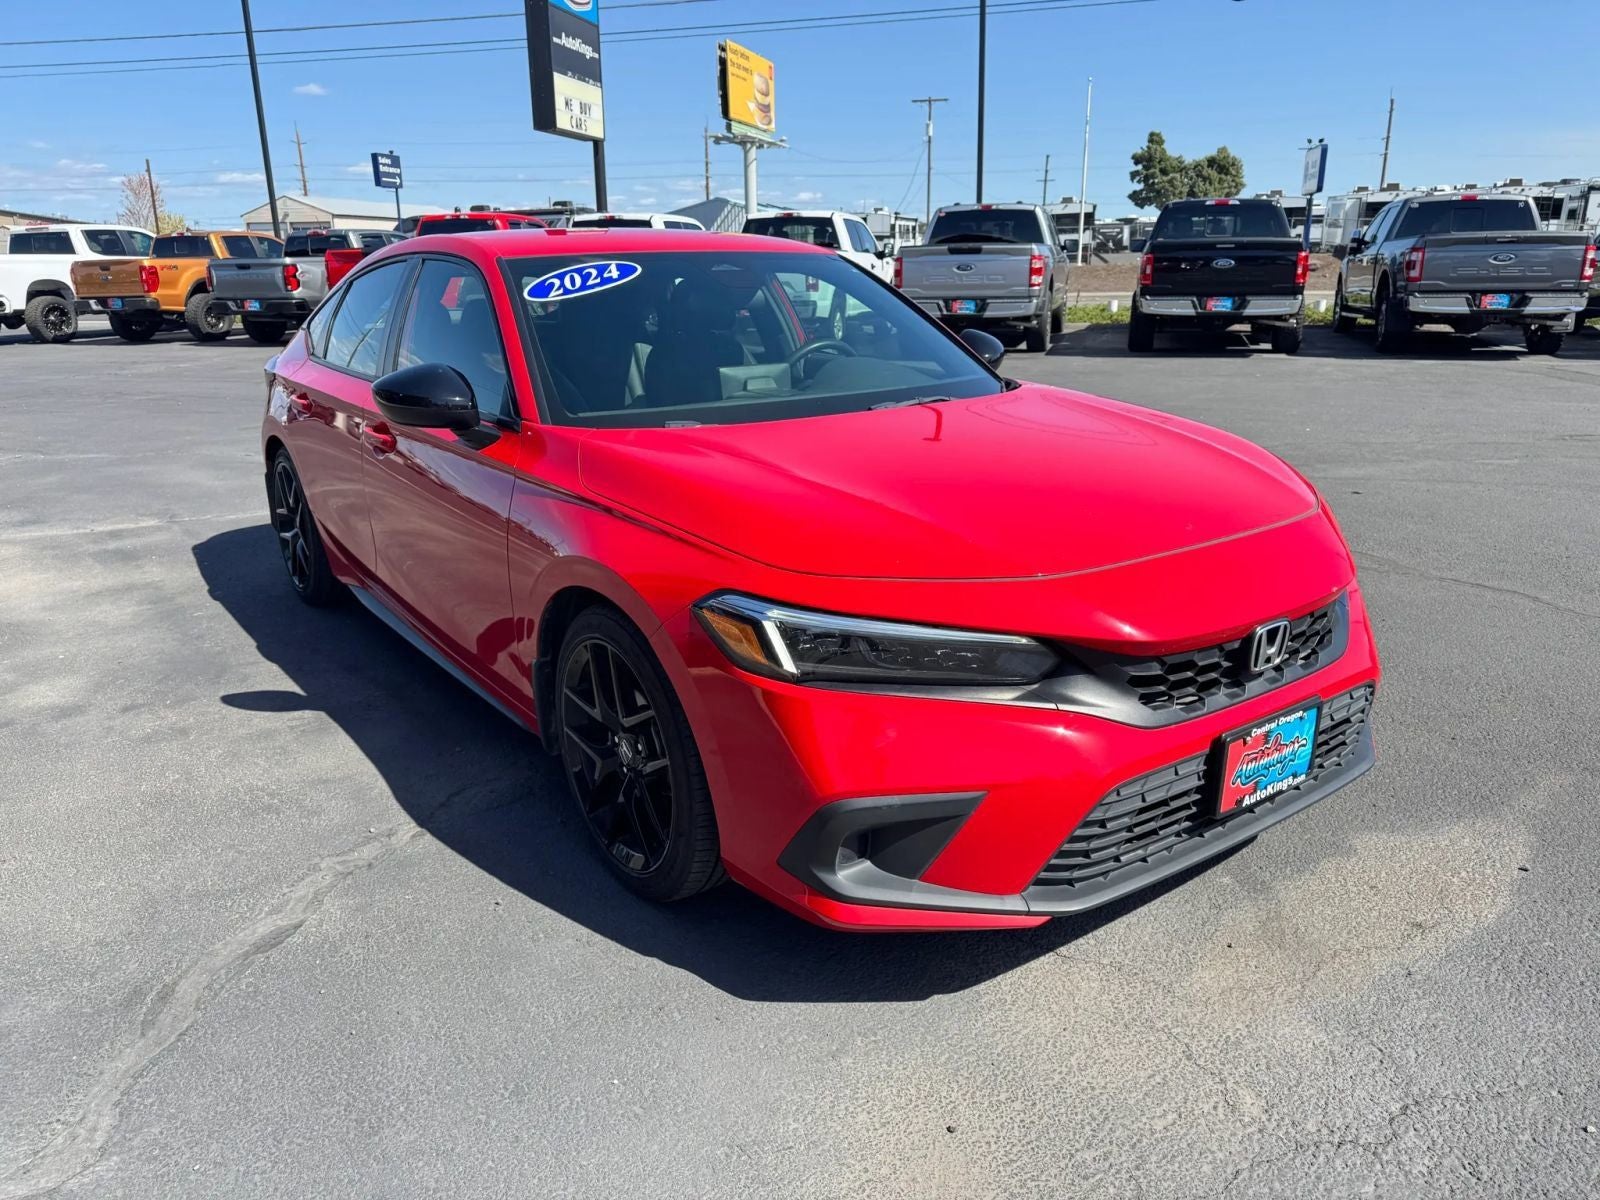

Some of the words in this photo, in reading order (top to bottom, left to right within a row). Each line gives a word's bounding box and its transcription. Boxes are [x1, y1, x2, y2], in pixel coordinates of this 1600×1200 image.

[579, 101, 592, 117] BUY
[570, 116, 588, 132] CARS
[545, 262, 620, 298] 2024
[1251, 721, 1279, 738] Central
[1278, 710, 1304, 726] Oregon
[1242, 773, 1307, 808] AutoKings.com
